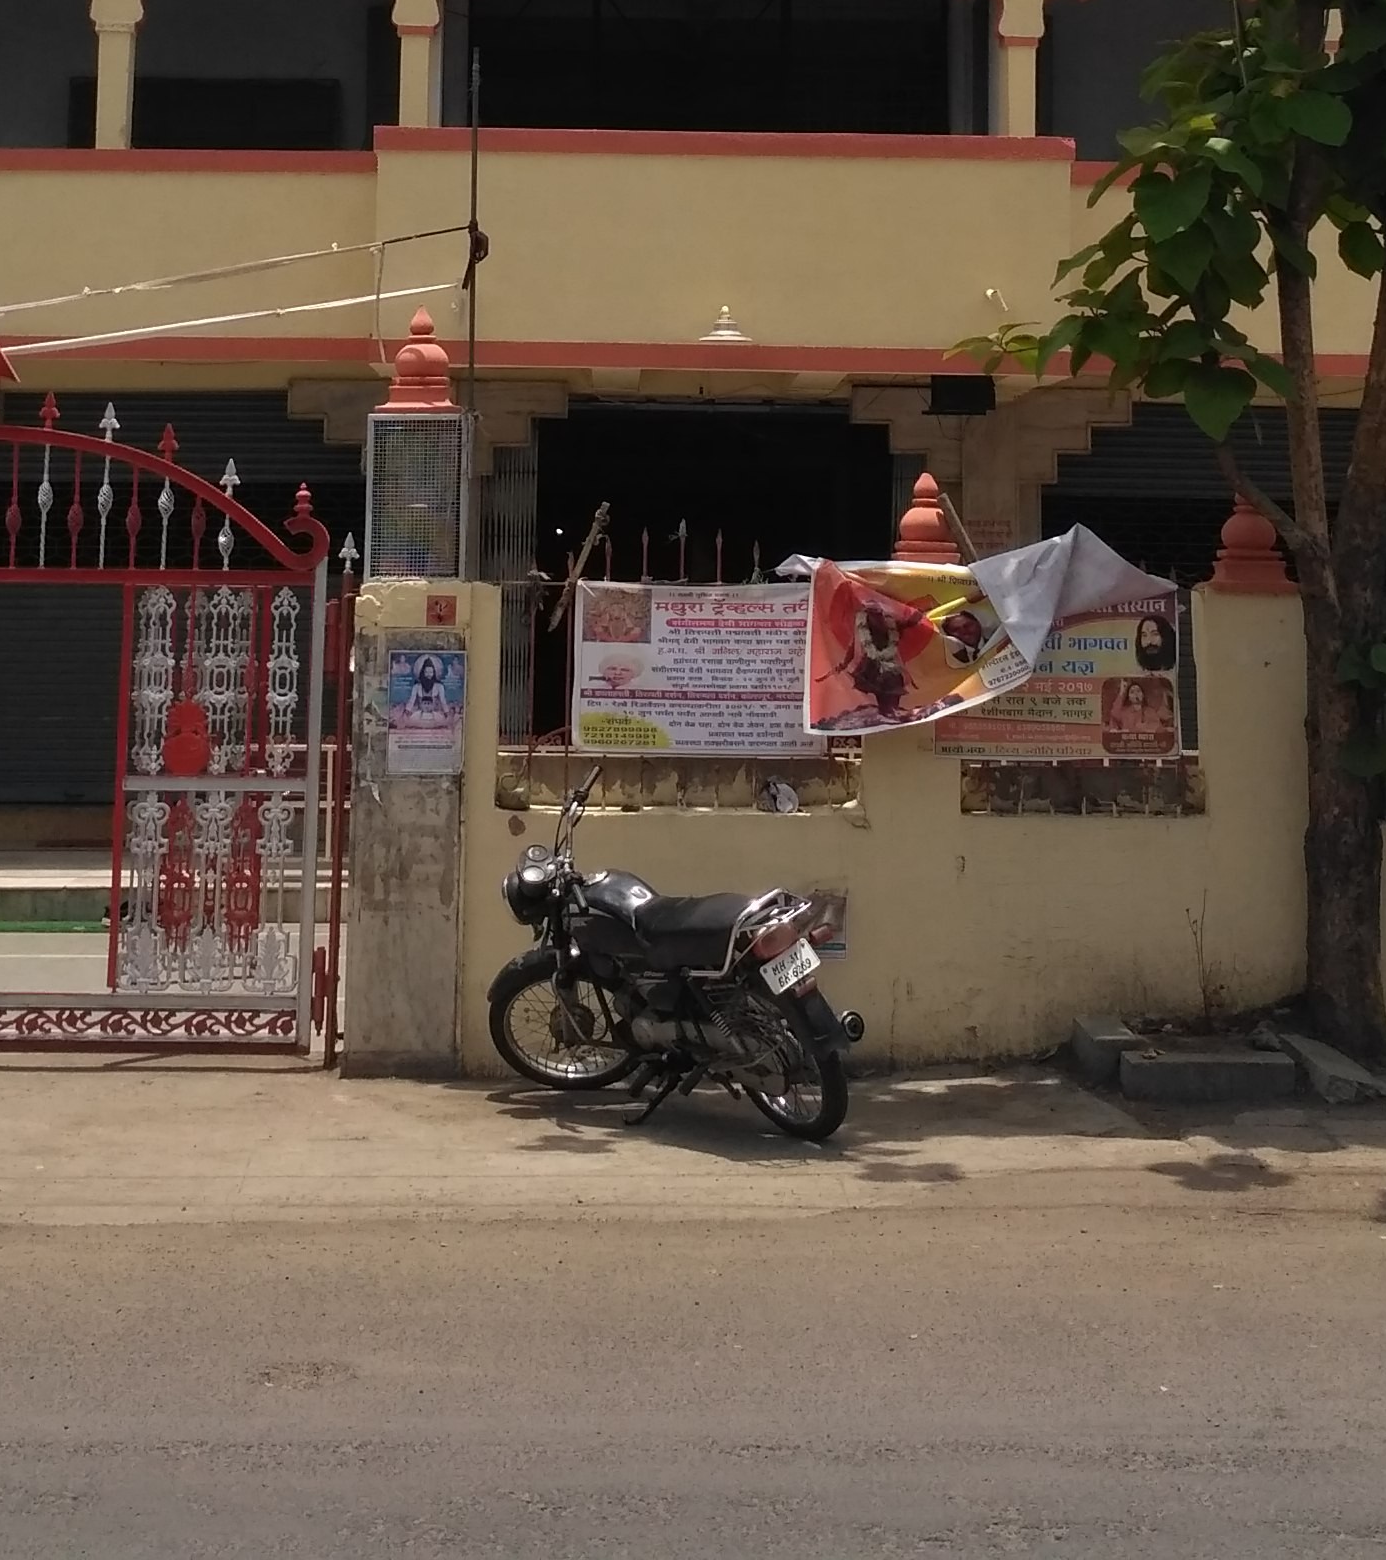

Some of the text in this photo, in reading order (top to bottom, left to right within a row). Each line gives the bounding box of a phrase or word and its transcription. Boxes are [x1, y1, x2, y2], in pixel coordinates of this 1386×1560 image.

[1068, 637, 1128, 651] भागवत
[1057, 682, 1093, 693] २०१७
[1006, 695, 1025, 705] रात
[1043, 695, 1062, 706] बजे
[1066, 696, 1088, 706] तक
